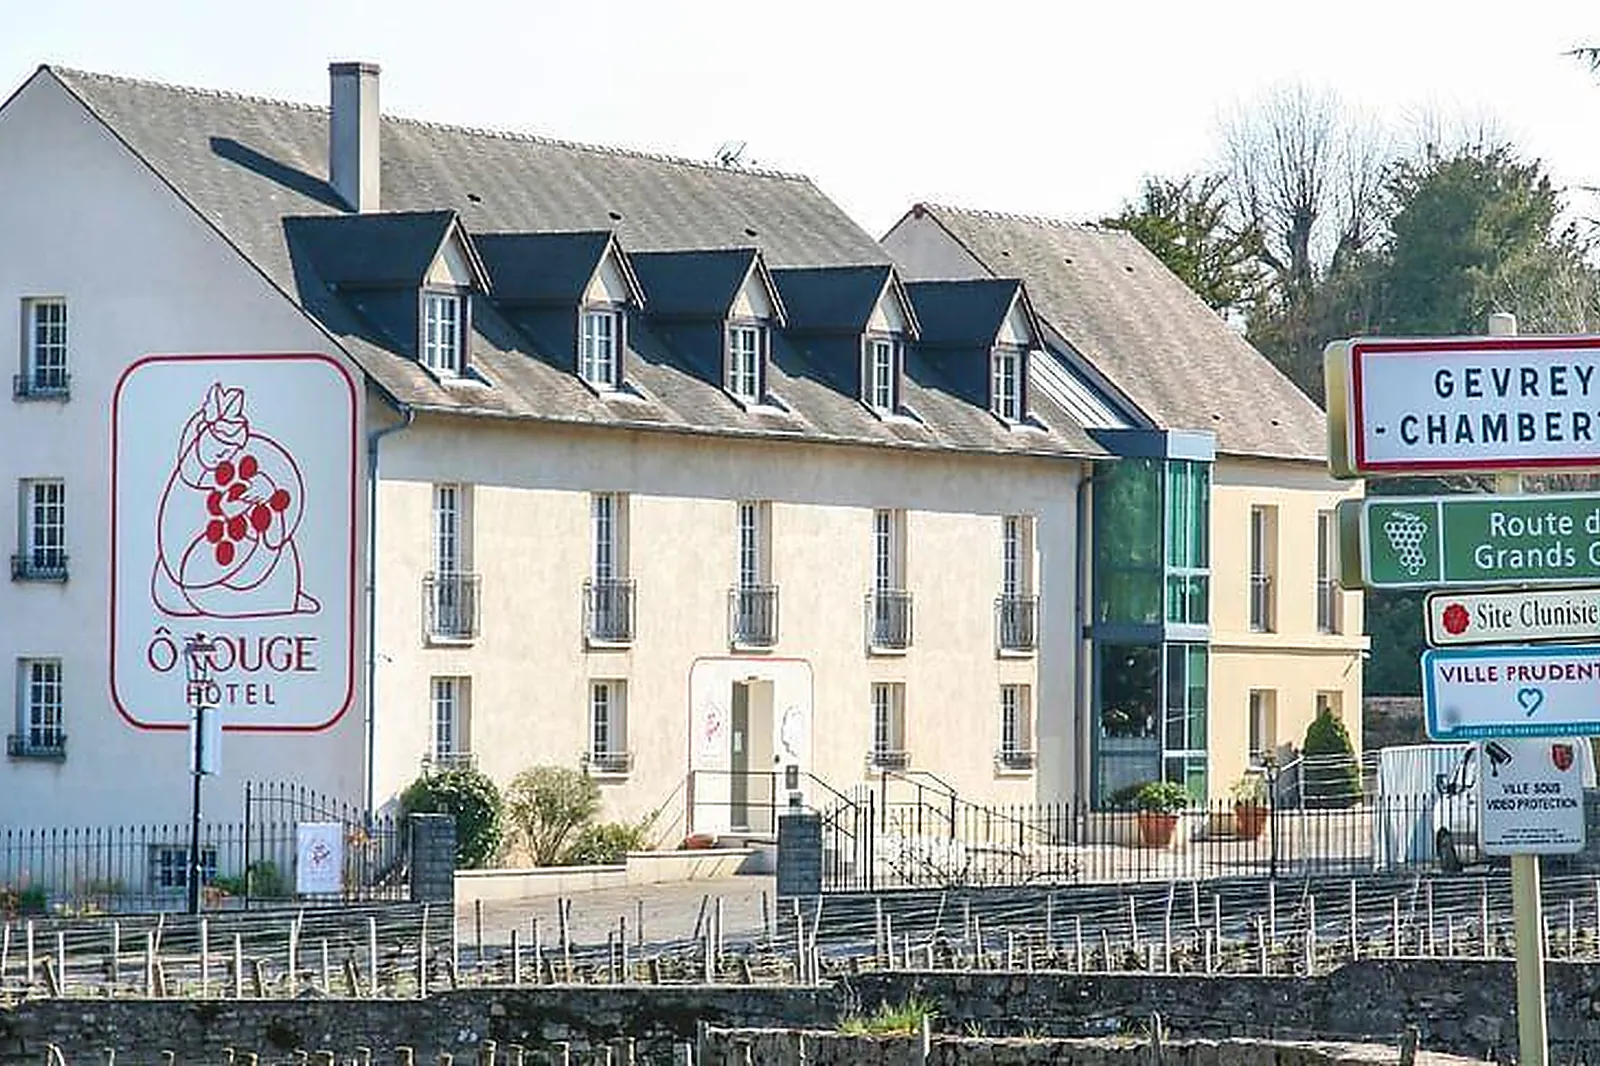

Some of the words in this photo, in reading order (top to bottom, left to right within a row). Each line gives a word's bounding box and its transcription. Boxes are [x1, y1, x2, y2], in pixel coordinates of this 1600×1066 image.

[1435, 365, 1594, 399] GEVREY
[1375, 410, 1600, 445] -CHAMBER
[1490, 511, 1573, 537] Route
[1474, 541, 1576, 569] Grands
[1477, 603, 1513, 629] Site
[1519, 600, 1598, 627] Clunisie
[1440, 665, 1499, 683] VILLE
[1502, 782, 1530, 795] VILLE
[1534, 782, 1561, 794] SOUS
[1486, 798, 1517, 811] VIDEO
[1517, 797, 1578, 811] PROTECTION
